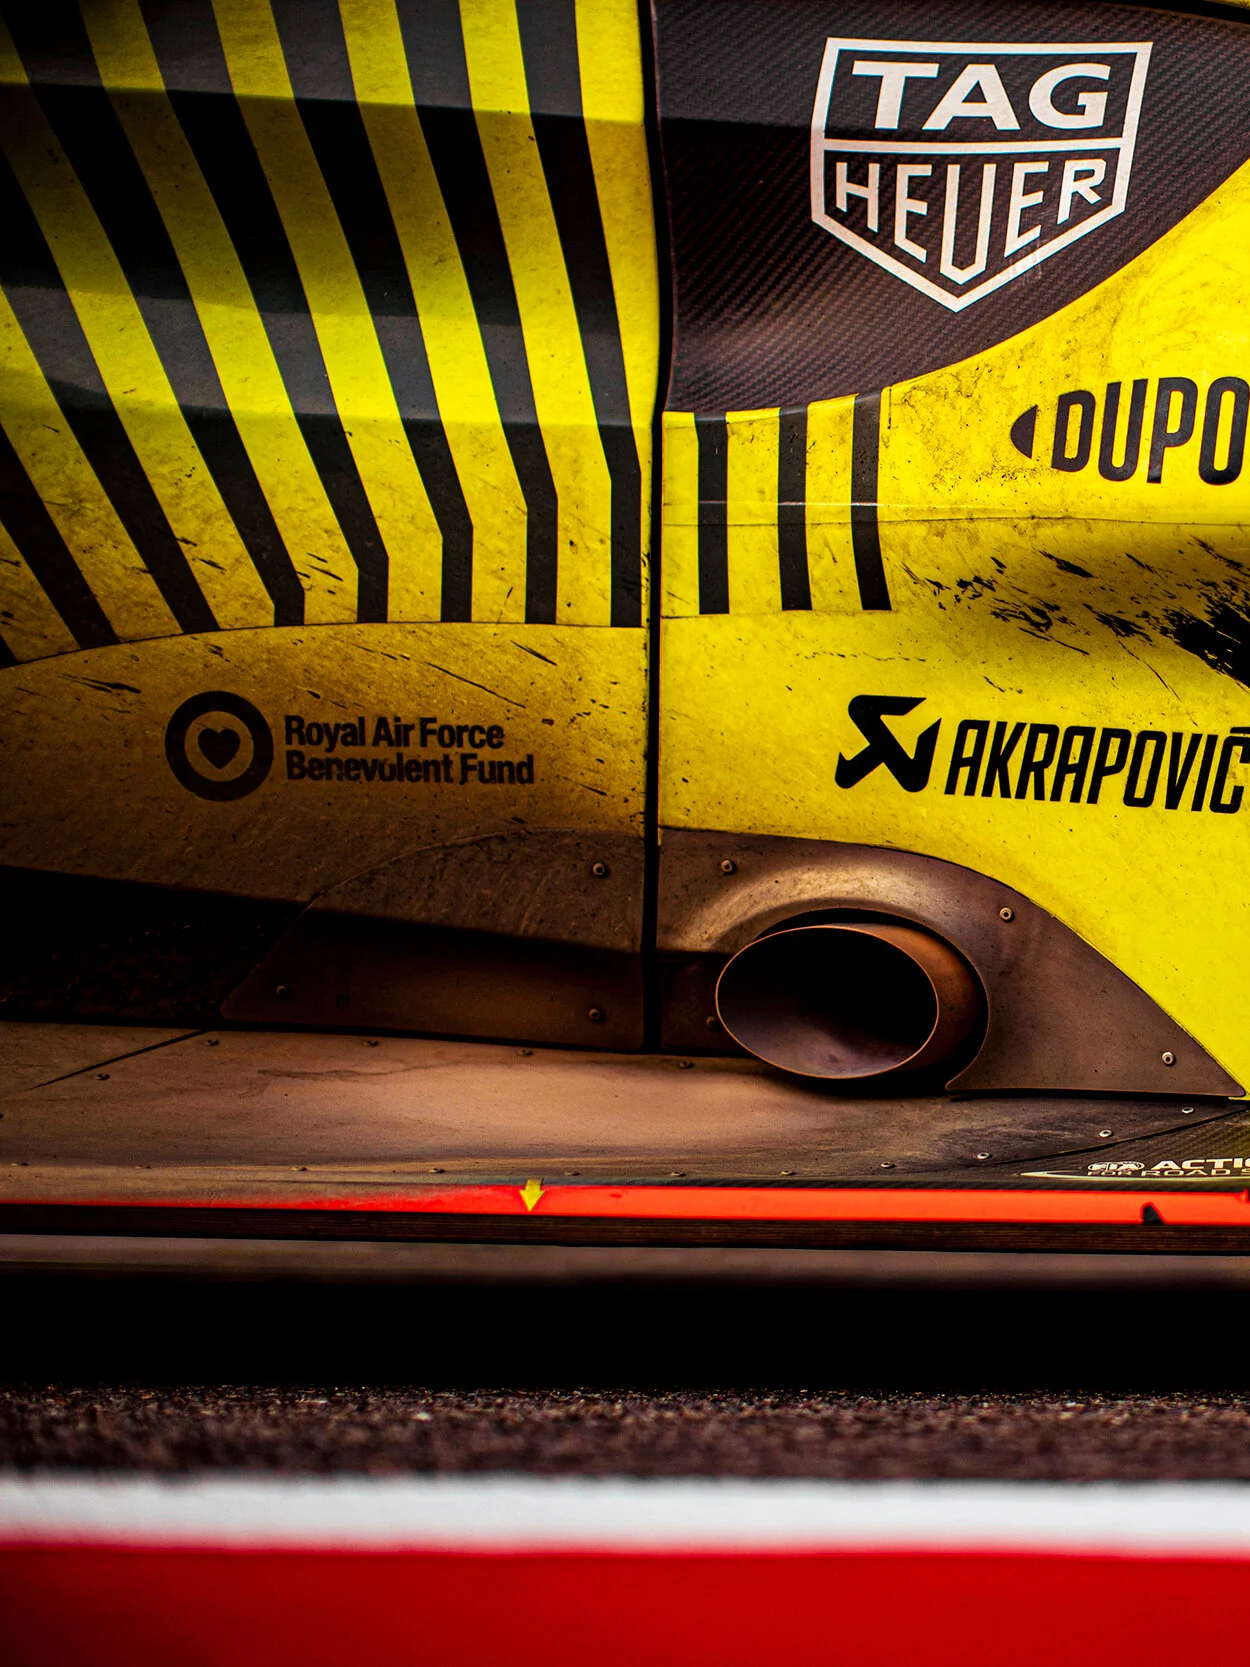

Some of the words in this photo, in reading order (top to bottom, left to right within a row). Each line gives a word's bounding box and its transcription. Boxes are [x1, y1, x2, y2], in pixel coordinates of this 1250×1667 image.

[852, 60, 1112, 131] TAG
[835, 158, 1107, 285] HEUER
[284, 715, 366, 752] Royal
[372, 717, 415, 747] Air
[420, 717, 505, 748] Force
[286, 750, 454, 783] Benevolent
[460, 753, 535, 785] Fund
[1140, 1169, 1233, 1177] ROAD
